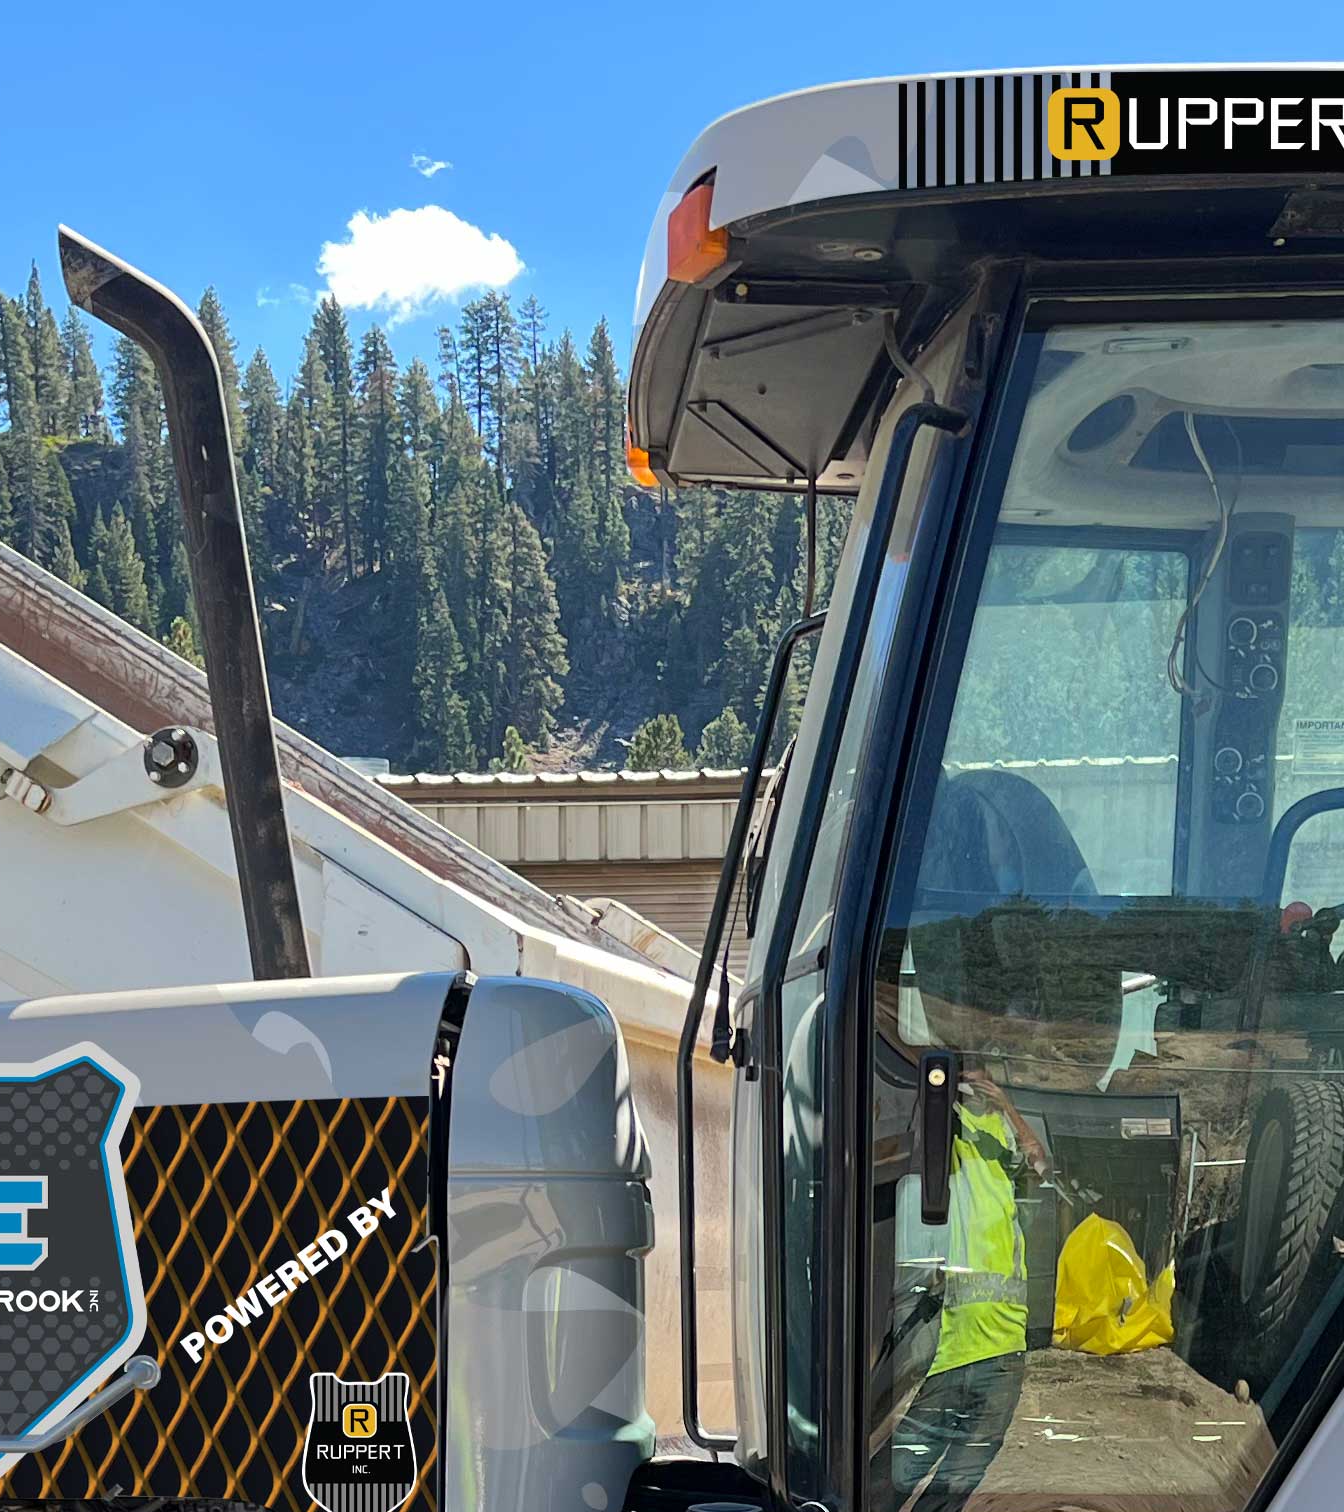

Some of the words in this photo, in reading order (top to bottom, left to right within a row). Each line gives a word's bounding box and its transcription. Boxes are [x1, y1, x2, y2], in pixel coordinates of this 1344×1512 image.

[180, 1229, 348, 1363] POWERED
[347, 1187, 396, 1239] BY
[317, 1445, 404, 1459] RUPPERT
[352, 1465, 370, 1474] INC.
